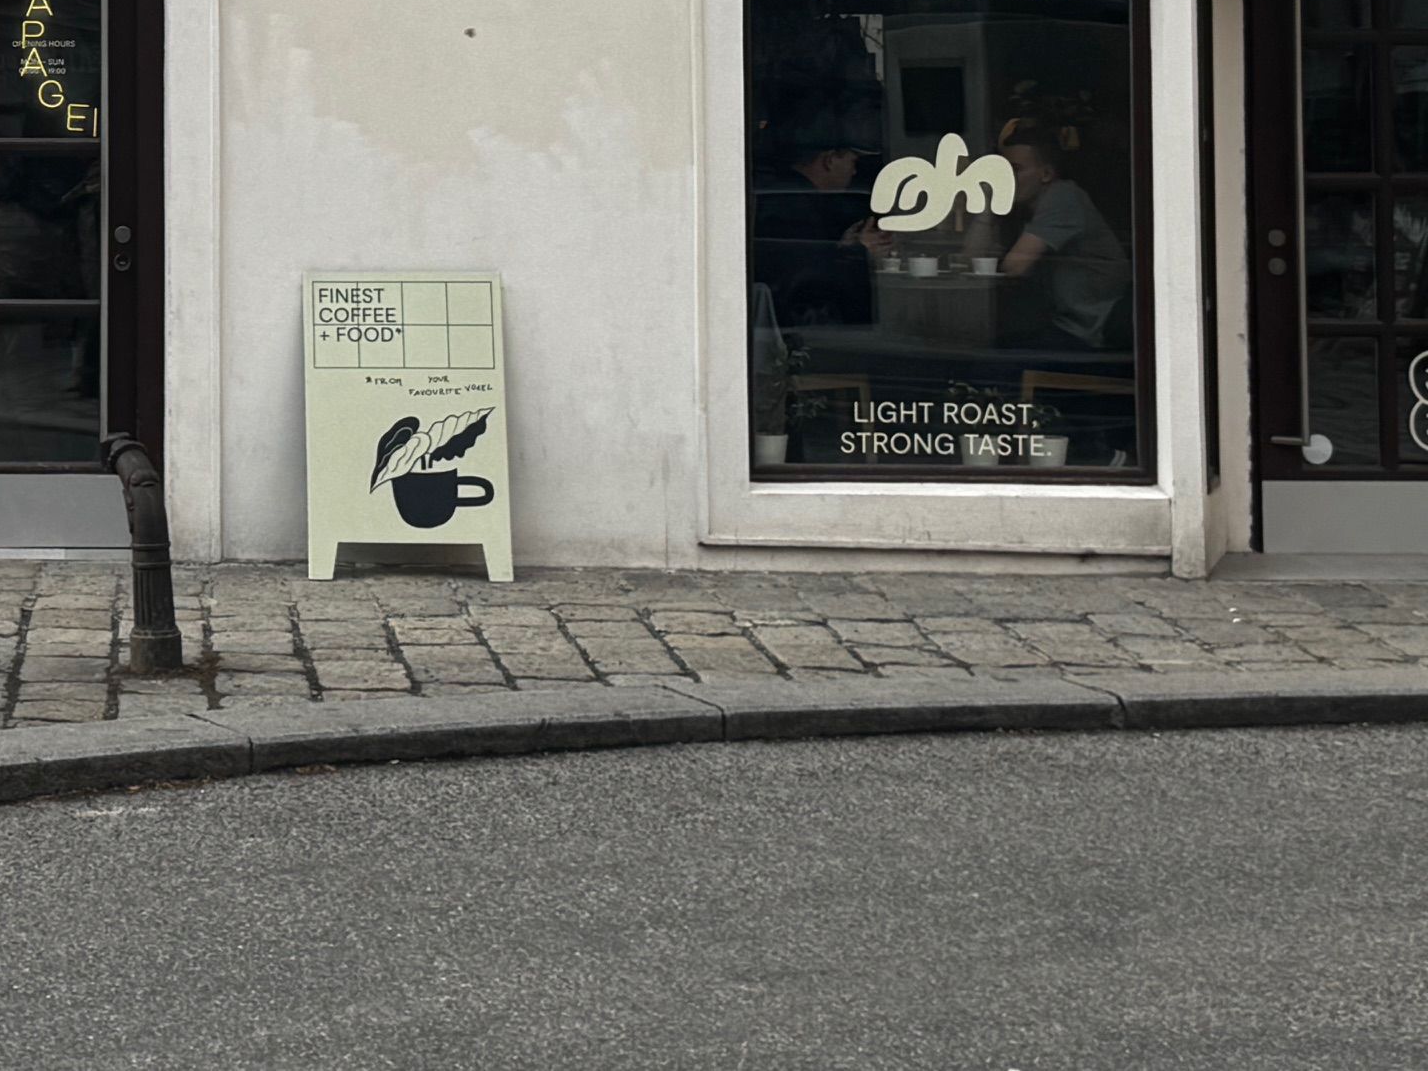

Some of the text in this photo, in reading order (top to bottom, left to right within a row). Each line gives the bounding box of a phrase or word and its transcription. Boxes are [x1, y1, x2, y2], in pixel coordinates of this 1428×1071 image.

[48, 40, 76, 48] HOURS
[318, 287, 384, 304] FINEST
[318, 307, 397, 323] COFFEE
[319, 330, 330, 341] +
[853, 401, 1038, 428] LIGHT ROAST,
[840, 432, 1053, 457] STRONG TASTE.
